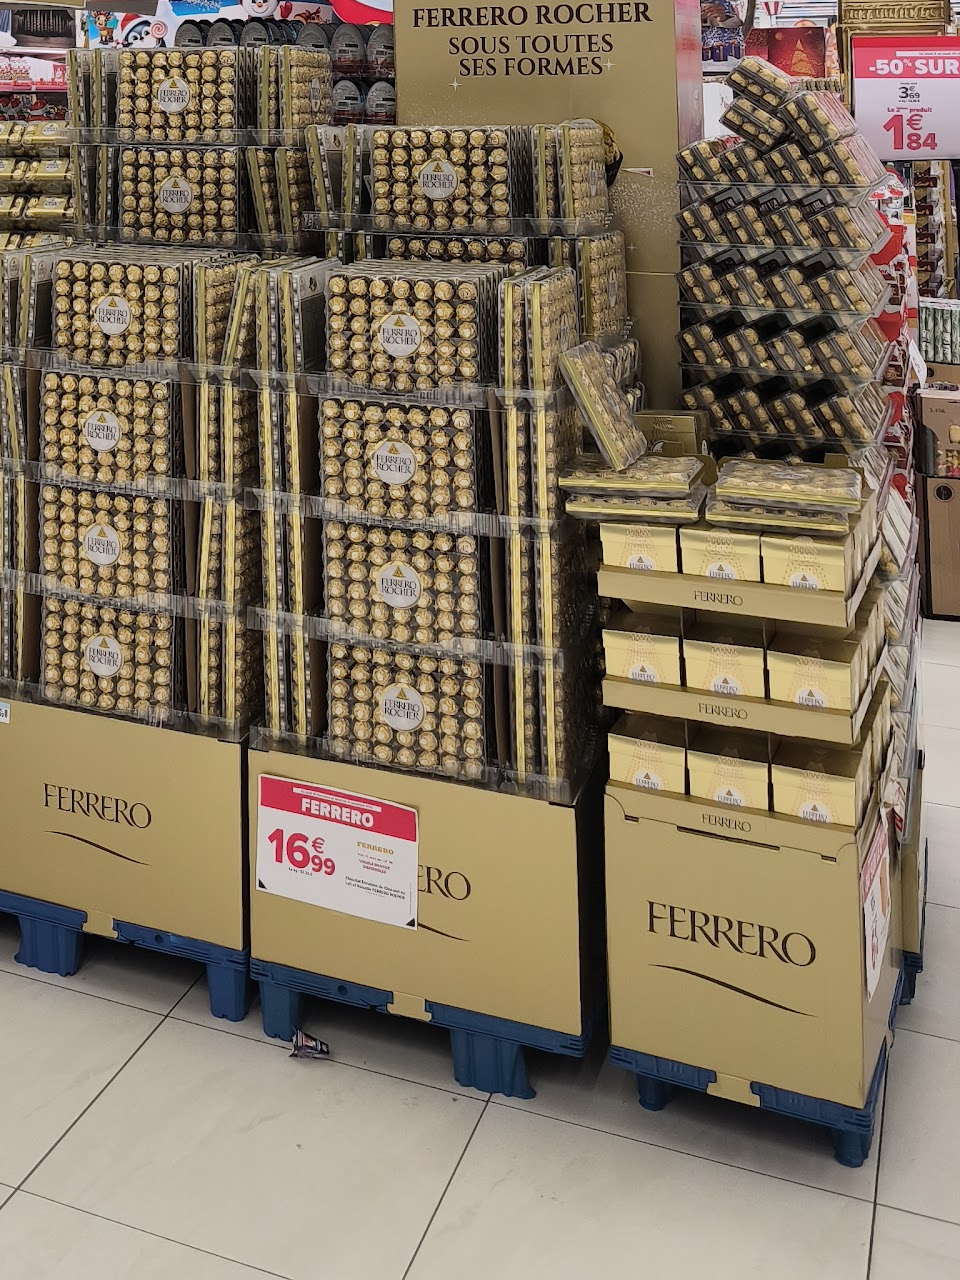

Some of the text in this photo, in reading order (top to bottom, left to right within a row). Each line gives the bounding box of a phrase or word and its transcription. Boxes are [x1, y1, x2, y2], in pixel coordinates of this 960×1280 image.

[412, 2, 653, 28] FERRERO ROCHER
[448, 33, 614, 55] SOUS TOUTES
[459, 57, 603, 77] SES FORMES
[914, 58, 959, 75] SUR
[98, 315, 127, 325] ROCHER
[382, 335, 418, 345] ROCHER
[87, 430, 116, 441] ROCHER
[376, 462, 412, 474] ROCHER
[87, 544, 117, 556] ROCHER
[381, 586, 417, 598] ROCHER
[693, 590, 743, 607] FERRERO
[89, 655, 119, 667] ROCHER
[384, 707, 420, 720] ROCHER
[698, 703, 748, 720] FERRERO
[43, 782, 152, 830] FERRERO
[301, 797, 374, 828] FERRERO
[702, 813, 751, 832] FERRERO
[646, 899, 817, 967] FERRERO
